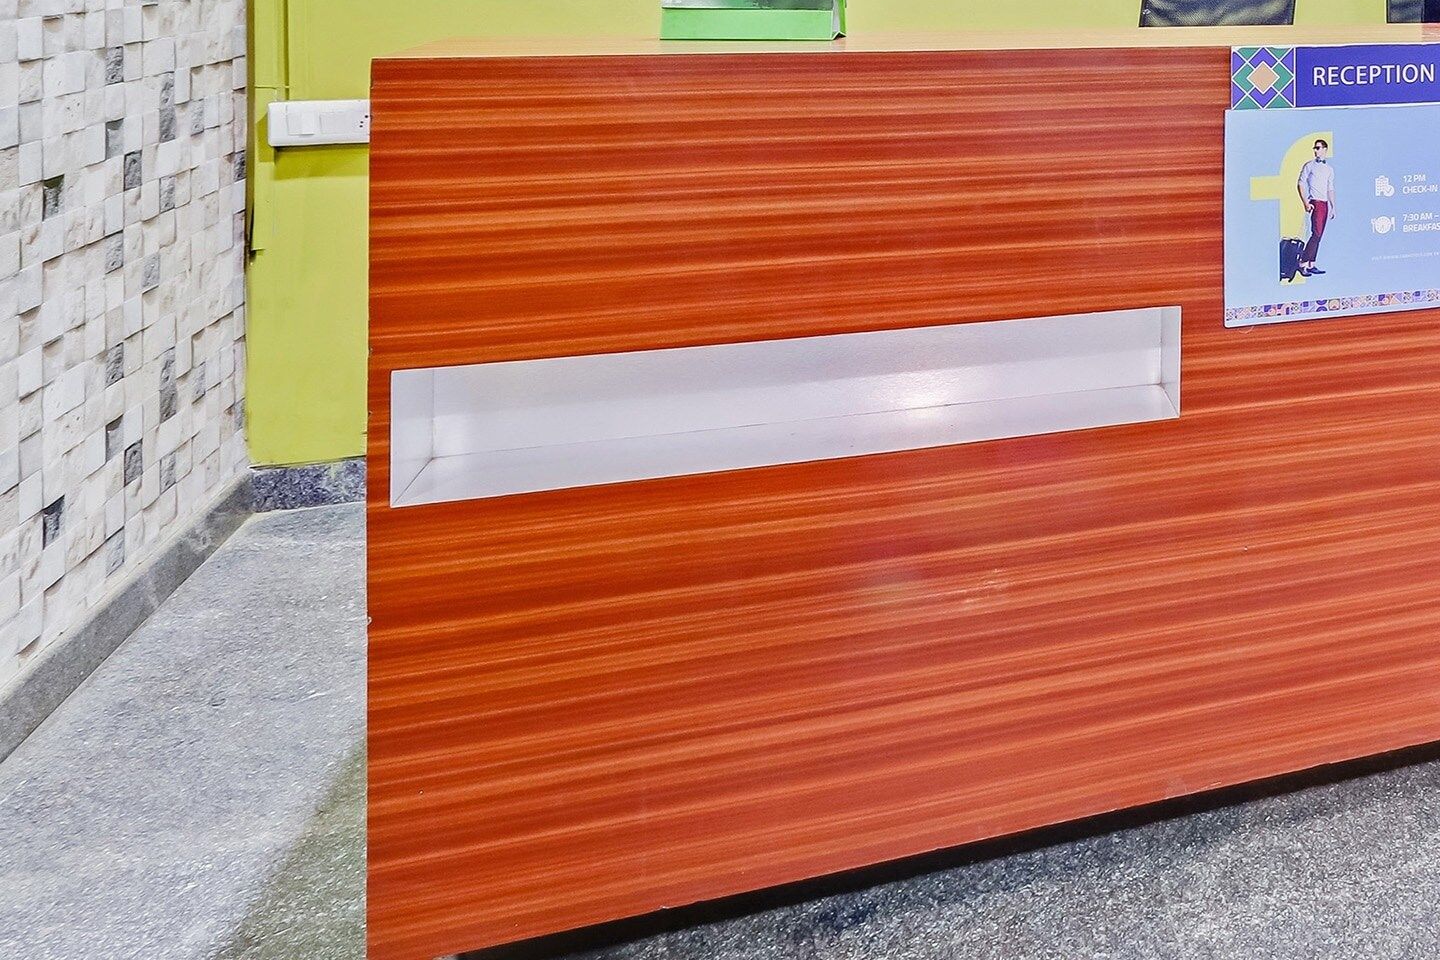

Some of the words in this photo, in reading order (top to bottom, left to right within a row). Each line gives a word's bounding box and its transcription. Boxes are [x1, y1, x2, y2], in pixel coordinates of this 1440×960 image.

[1313, 63, 1436, 86] RECEPTION
[1403, 175, 1412, 183] 12
[1413, 174, 1426, 182] PM
[1402, 184, 1438, 194] CHECK-IN
[1402, 213, 1419, 222] 7:30
[1420, 212, 1433, 220] AM
